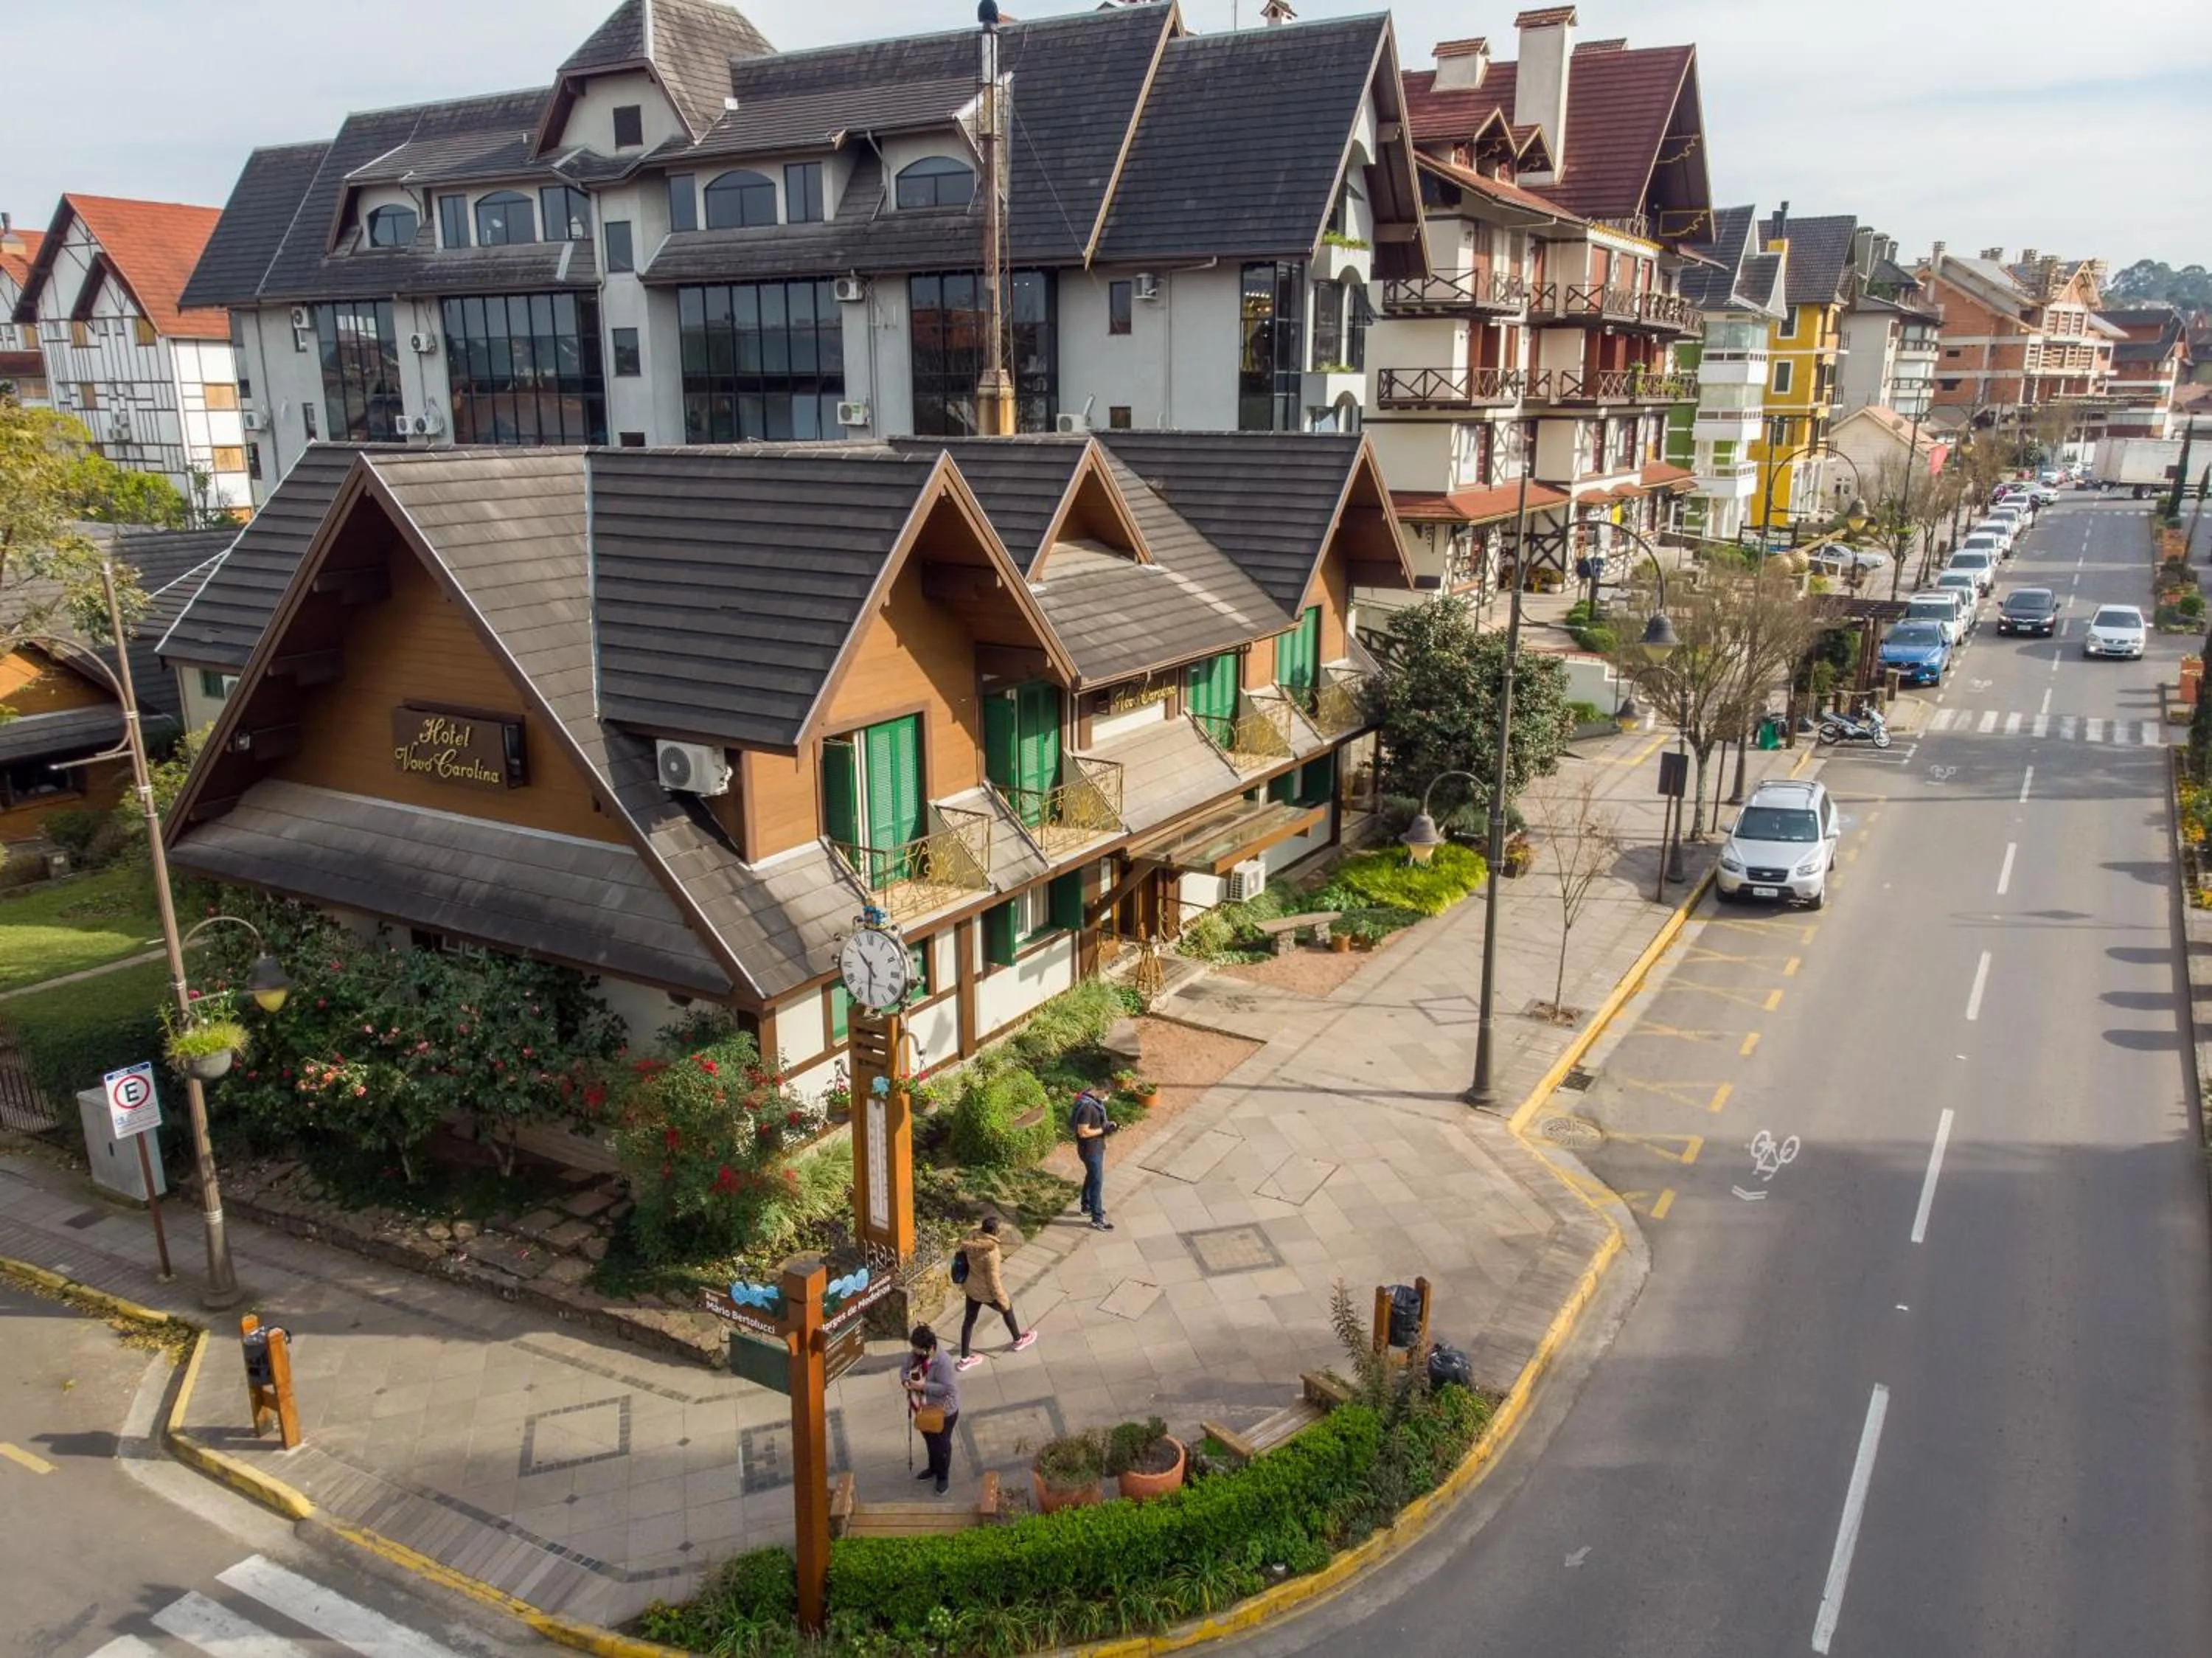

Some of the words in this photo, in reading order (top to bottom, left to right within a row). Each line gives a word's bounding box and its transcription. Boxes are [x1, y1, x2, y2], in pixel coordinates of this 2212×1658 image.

[419, 718, 470, 747] Hotel
[433, 749, 500, 783] Carolina
[124, 1081, 139, 1102] E
